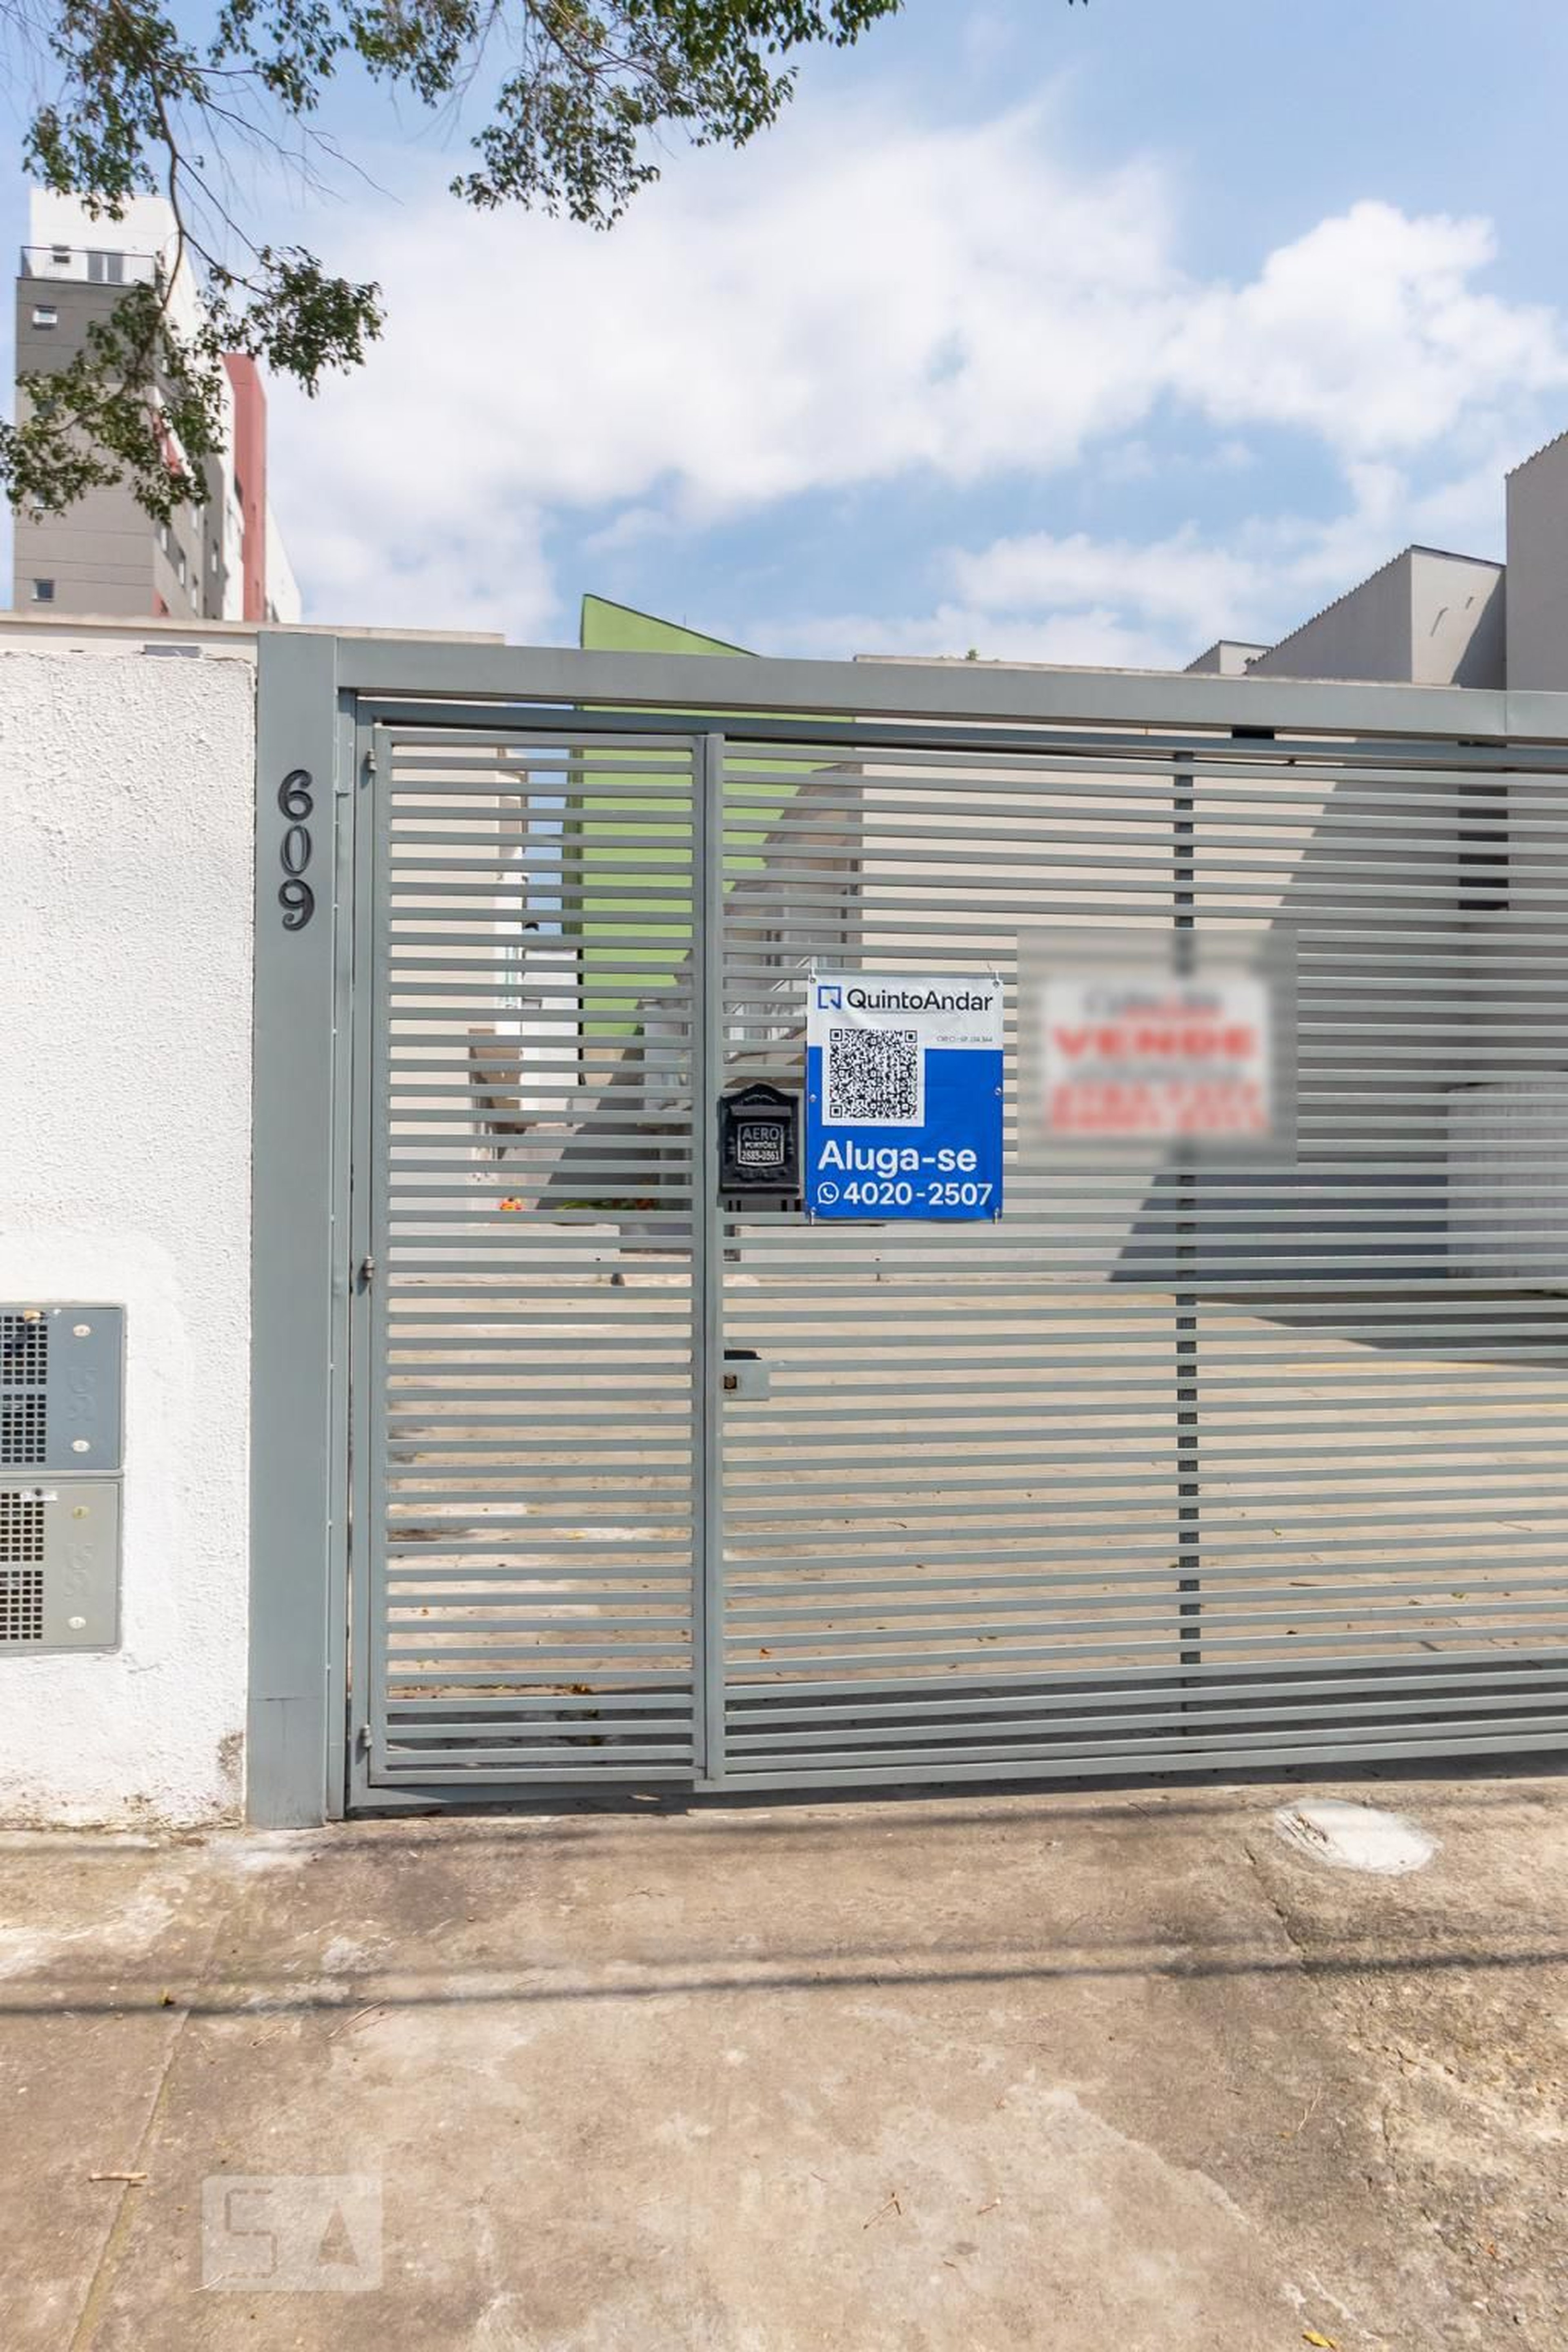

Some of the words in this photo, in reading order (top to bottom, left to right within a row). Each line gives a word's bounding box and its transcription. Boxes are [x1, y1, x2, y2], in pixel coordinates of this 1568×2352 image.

[278, 769, 314, 931] 609
[847, 989, 993, 1011] QuintoAndar
[742, 1127, 780, 1140] AERO
[818, 1140, 977, 1179] Aluga-se
[843, 1182, 993, 1205] 4020-2507
